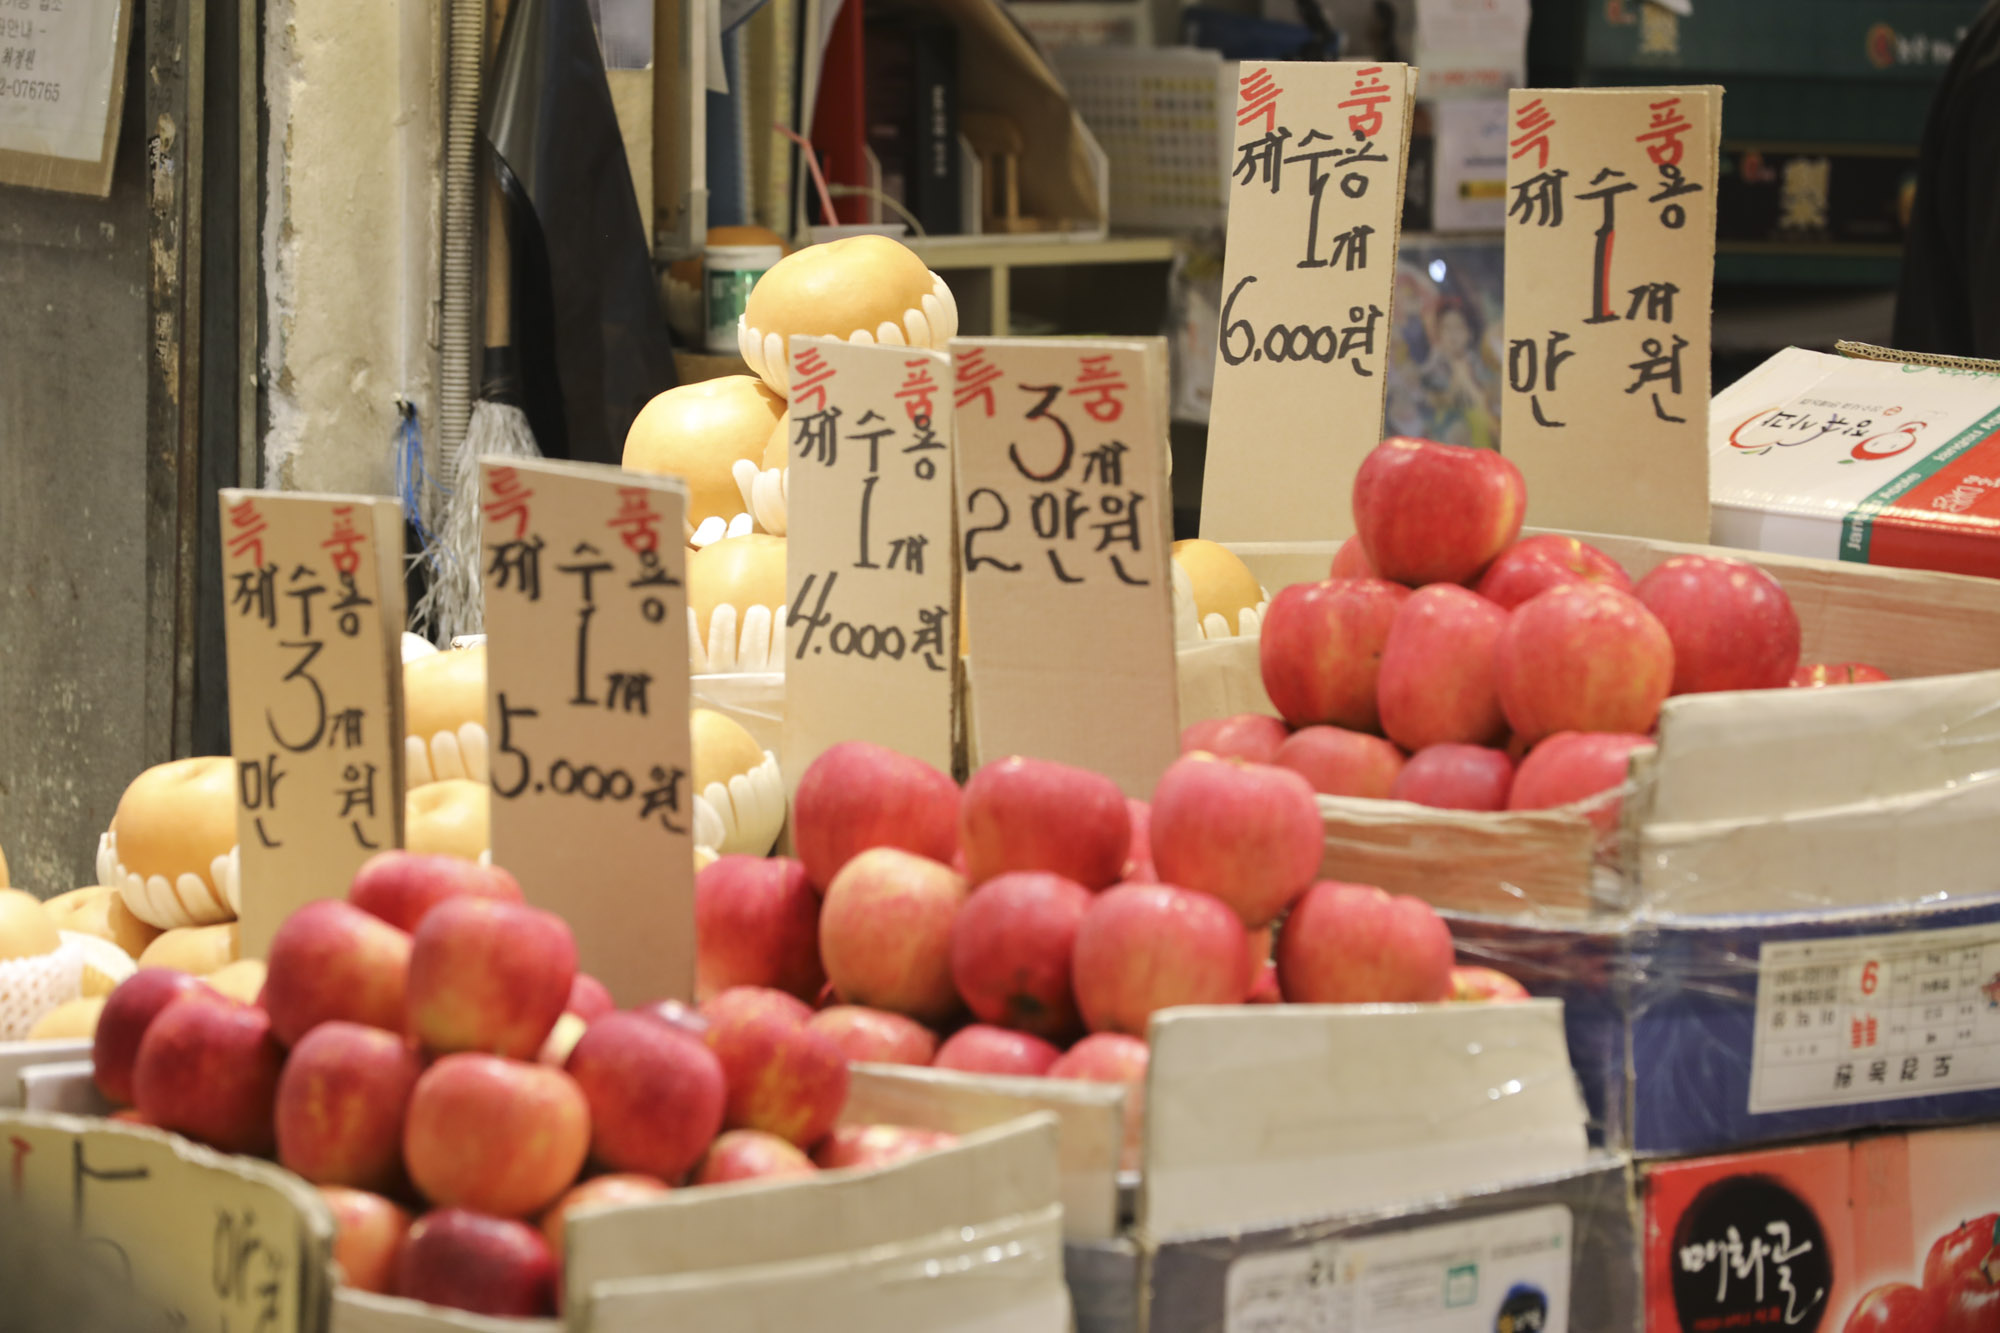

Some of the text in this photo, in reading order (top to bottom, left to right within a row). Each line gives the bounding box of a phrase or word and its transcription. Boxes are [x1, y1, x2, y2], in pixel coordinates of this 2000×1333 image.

[1232, 126, 1388, 199] 제수용
[1508, 163, 1703, 229] 제수용
[792, 405, 948, 480] 제수용
[230, 563, 373, 637] 제수용
[486, 533, 682, 624] 제수용
